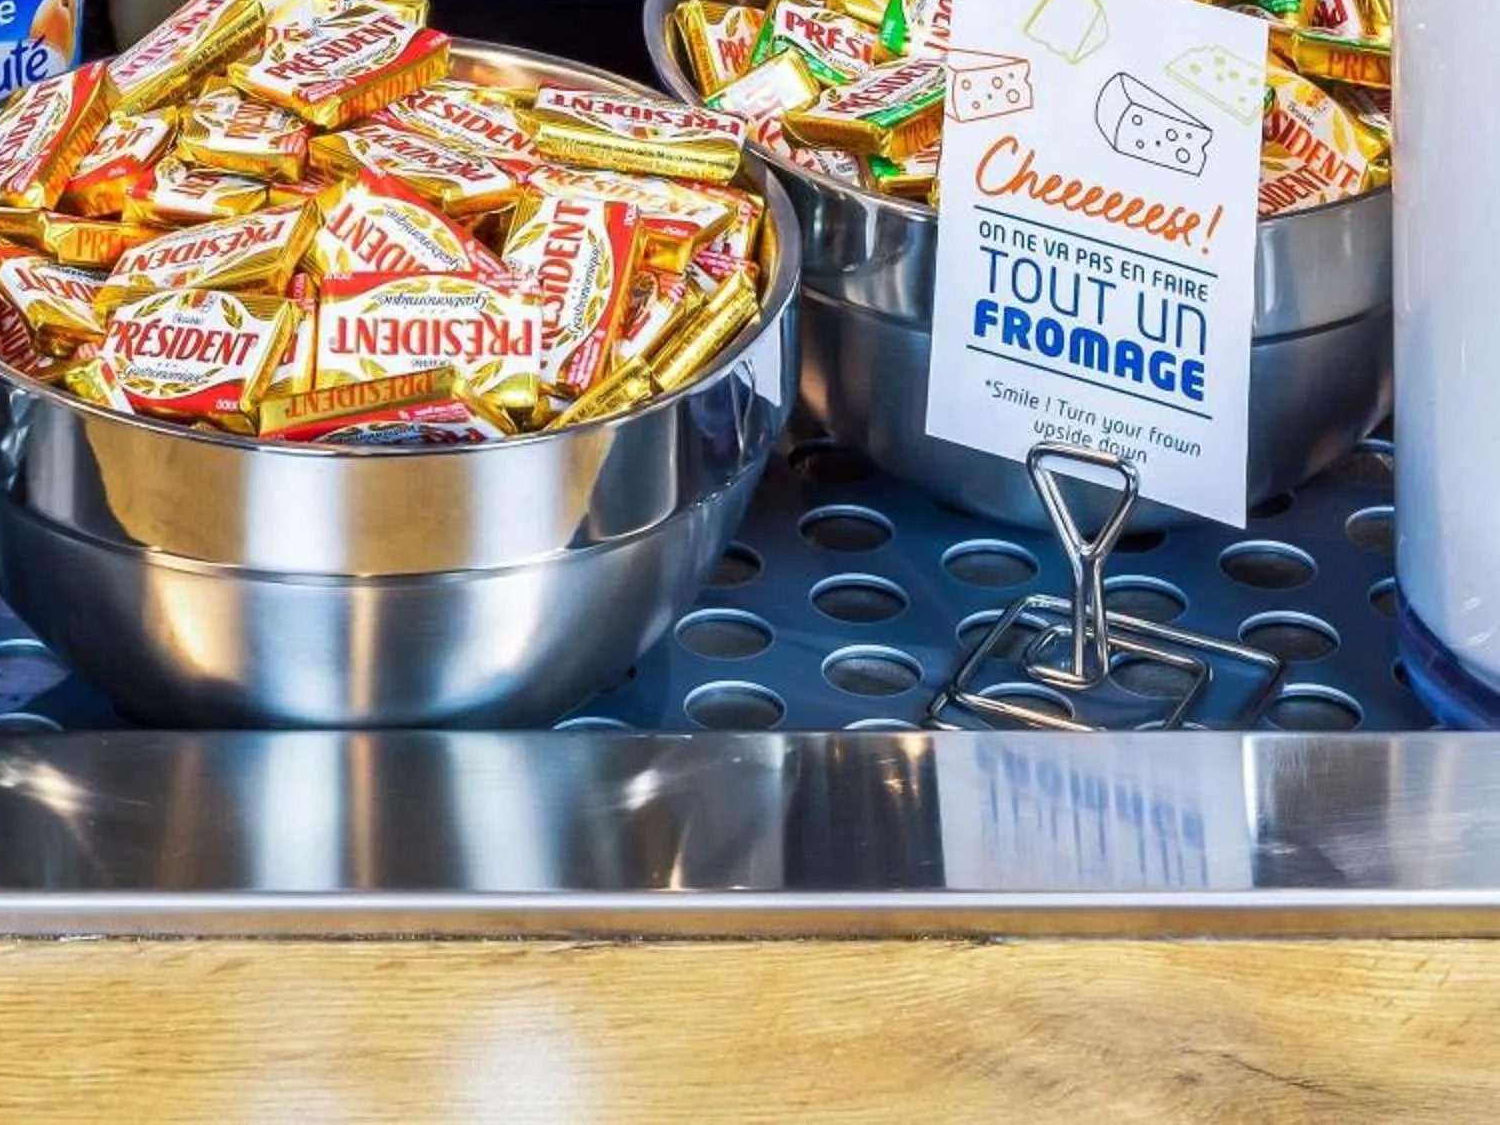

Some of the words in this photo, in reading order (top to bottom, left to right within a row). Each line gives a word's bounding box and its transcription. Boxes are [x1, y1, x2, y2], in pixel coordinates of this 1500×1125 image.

[262, 14, 407, 80] PRÉSIDENT
[551, 94, 743, 137] PRÉSIDENT
[120, 220, 285, 276] PRÉSIDENT
[979, 220, 1006, 244] ON
[1013, 231, 1037, 253] NE
[1044, 239, 1069, 261] VA
[1076, 249, 1114, 274] PAS
[1121, 260, 1146, 284] EN
[1152, 271, 1209, 302] FAIRE
[378, 294, 489, 312] Gastronomique
[980, 246, 1117, 325] TOUT
[1137, 290, 1208, 356] UN
[111, 319, 259, 365] PRÉSIDENT
[330, 312, 533, 364] PRÉSIDENT
[973, 299, 1205, 402] FROMAGE
[285, 370, 438, 418] PRÉSIDENT
[1034, 420, 1093, 449] upside
[1099, 435, 1148, 464] down
[1045, 398, 1051, 412] !
[1055, 400, 1097, 426] Turn
[1102, 418, 1144, 440] your
[1149, 425, 1202, 457] frown
